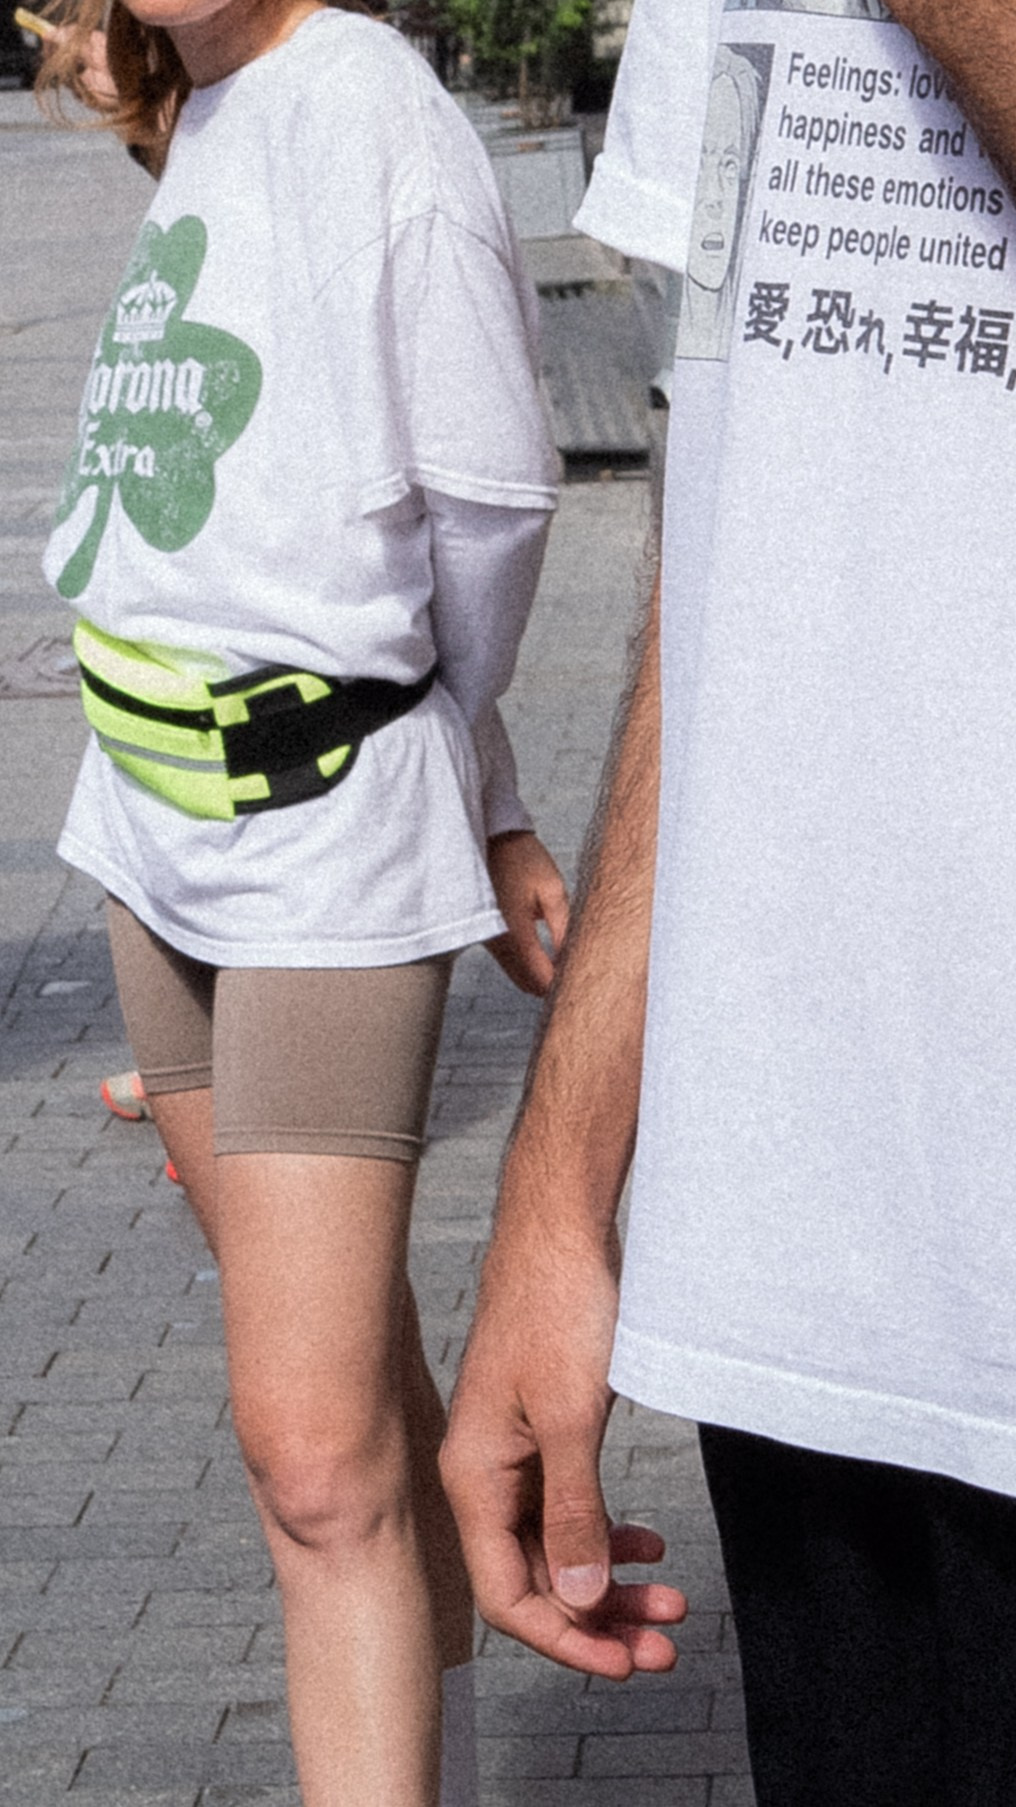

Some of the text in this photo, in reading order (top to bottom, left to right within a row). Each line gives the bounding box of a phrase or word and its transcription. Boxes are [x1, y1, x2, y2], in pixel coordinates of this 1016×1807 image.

[787, 51, 956, 103] Feelings: lov
[778, 104, 906, 152] happiness
[918, 122, 968, 157] and
[768, 159, 1004, 215] all these emotions
[758, 210, 1008, 271] keep people united
